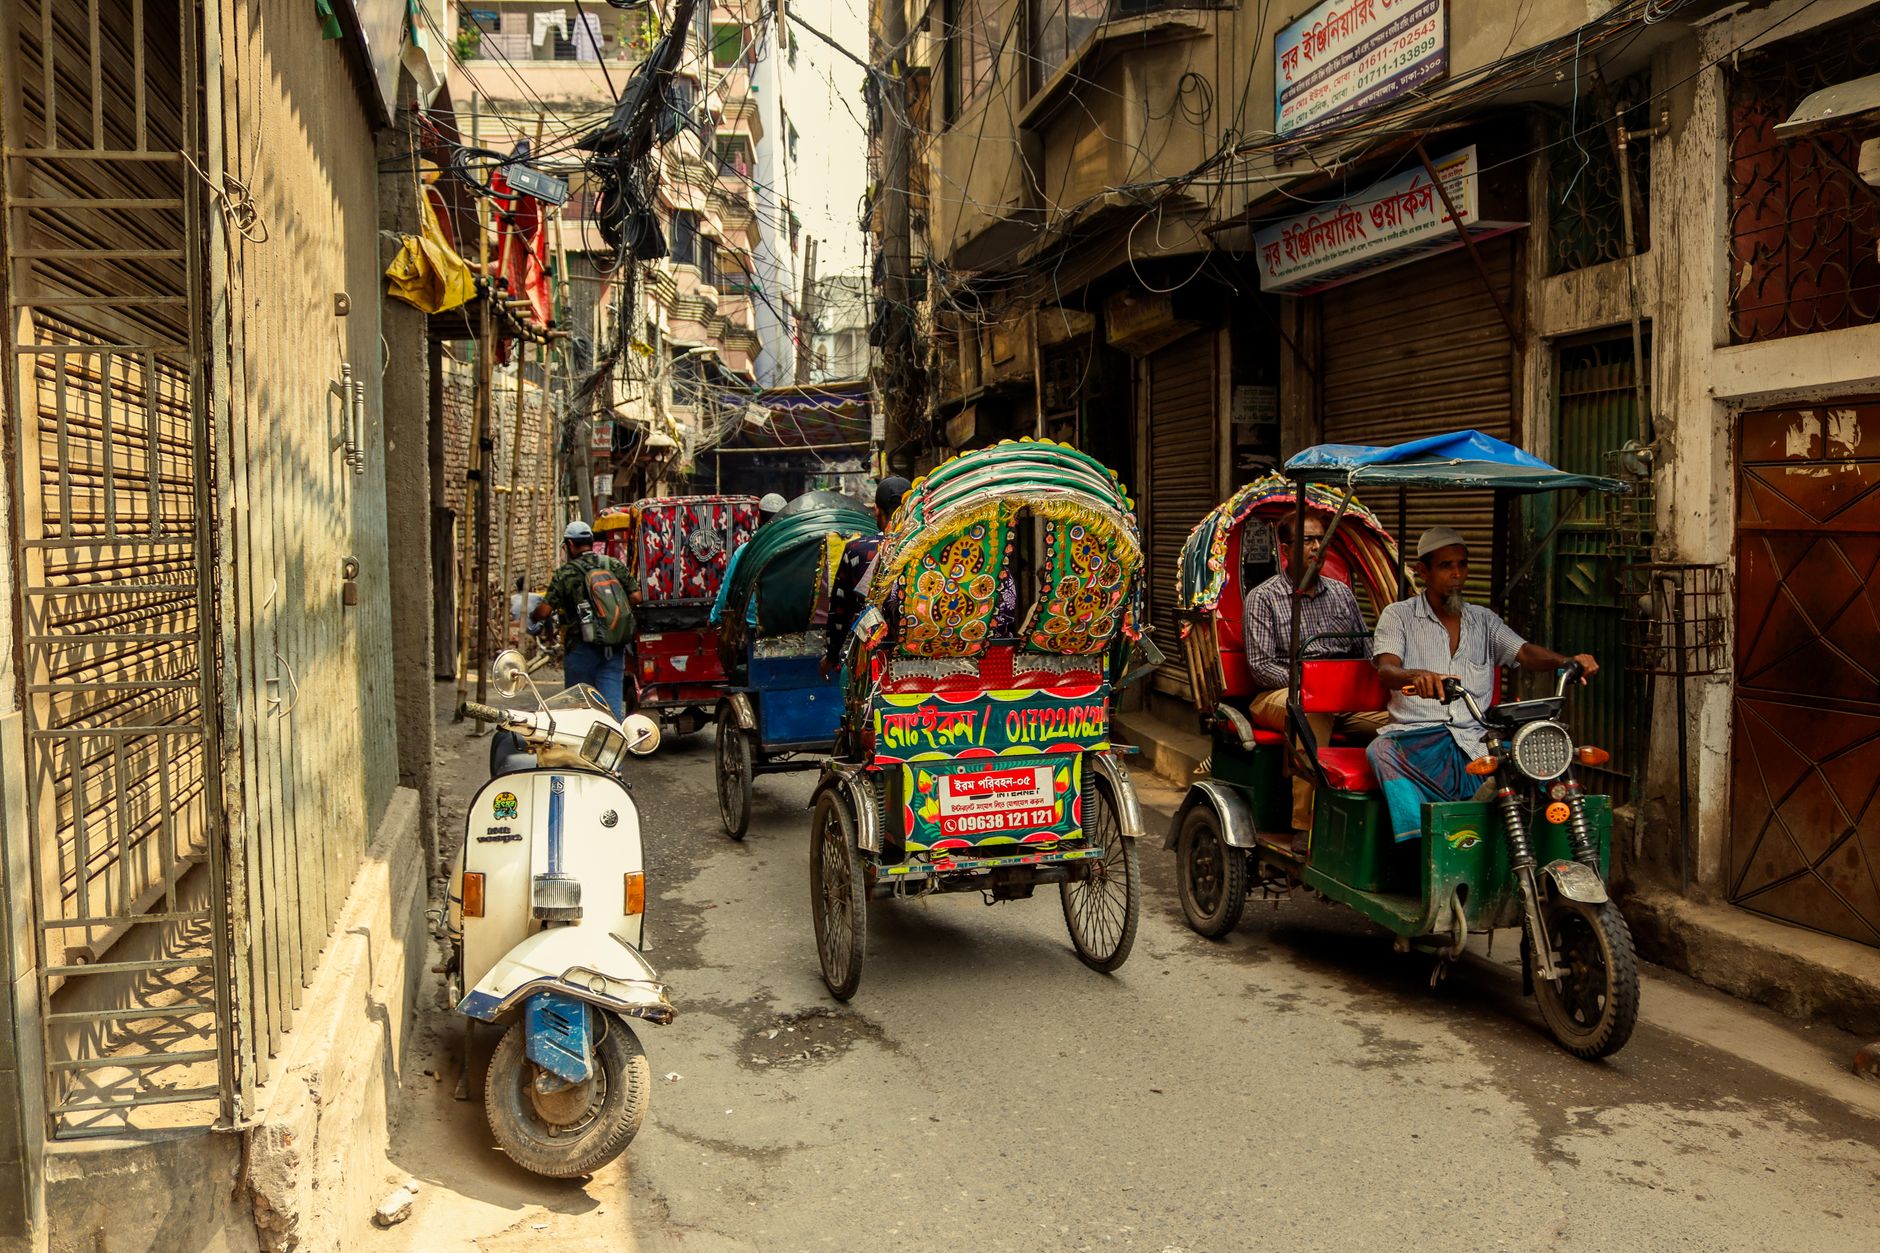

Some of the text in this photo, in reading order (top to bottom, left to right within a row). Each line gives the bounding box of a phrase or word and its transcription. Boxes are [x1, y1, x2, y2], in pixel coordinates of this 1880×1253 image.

[1281, 45, 1299, 81] নূর
[1358, 19, 1436, 74] 01611-702543
[1358, 36, 1436, 90] 01711-133899
[1262, 244, 1281, 277] নূর
[954, 779, 975, 792] ইরম
[958, 809, 1053, 831] 09638 121 121
